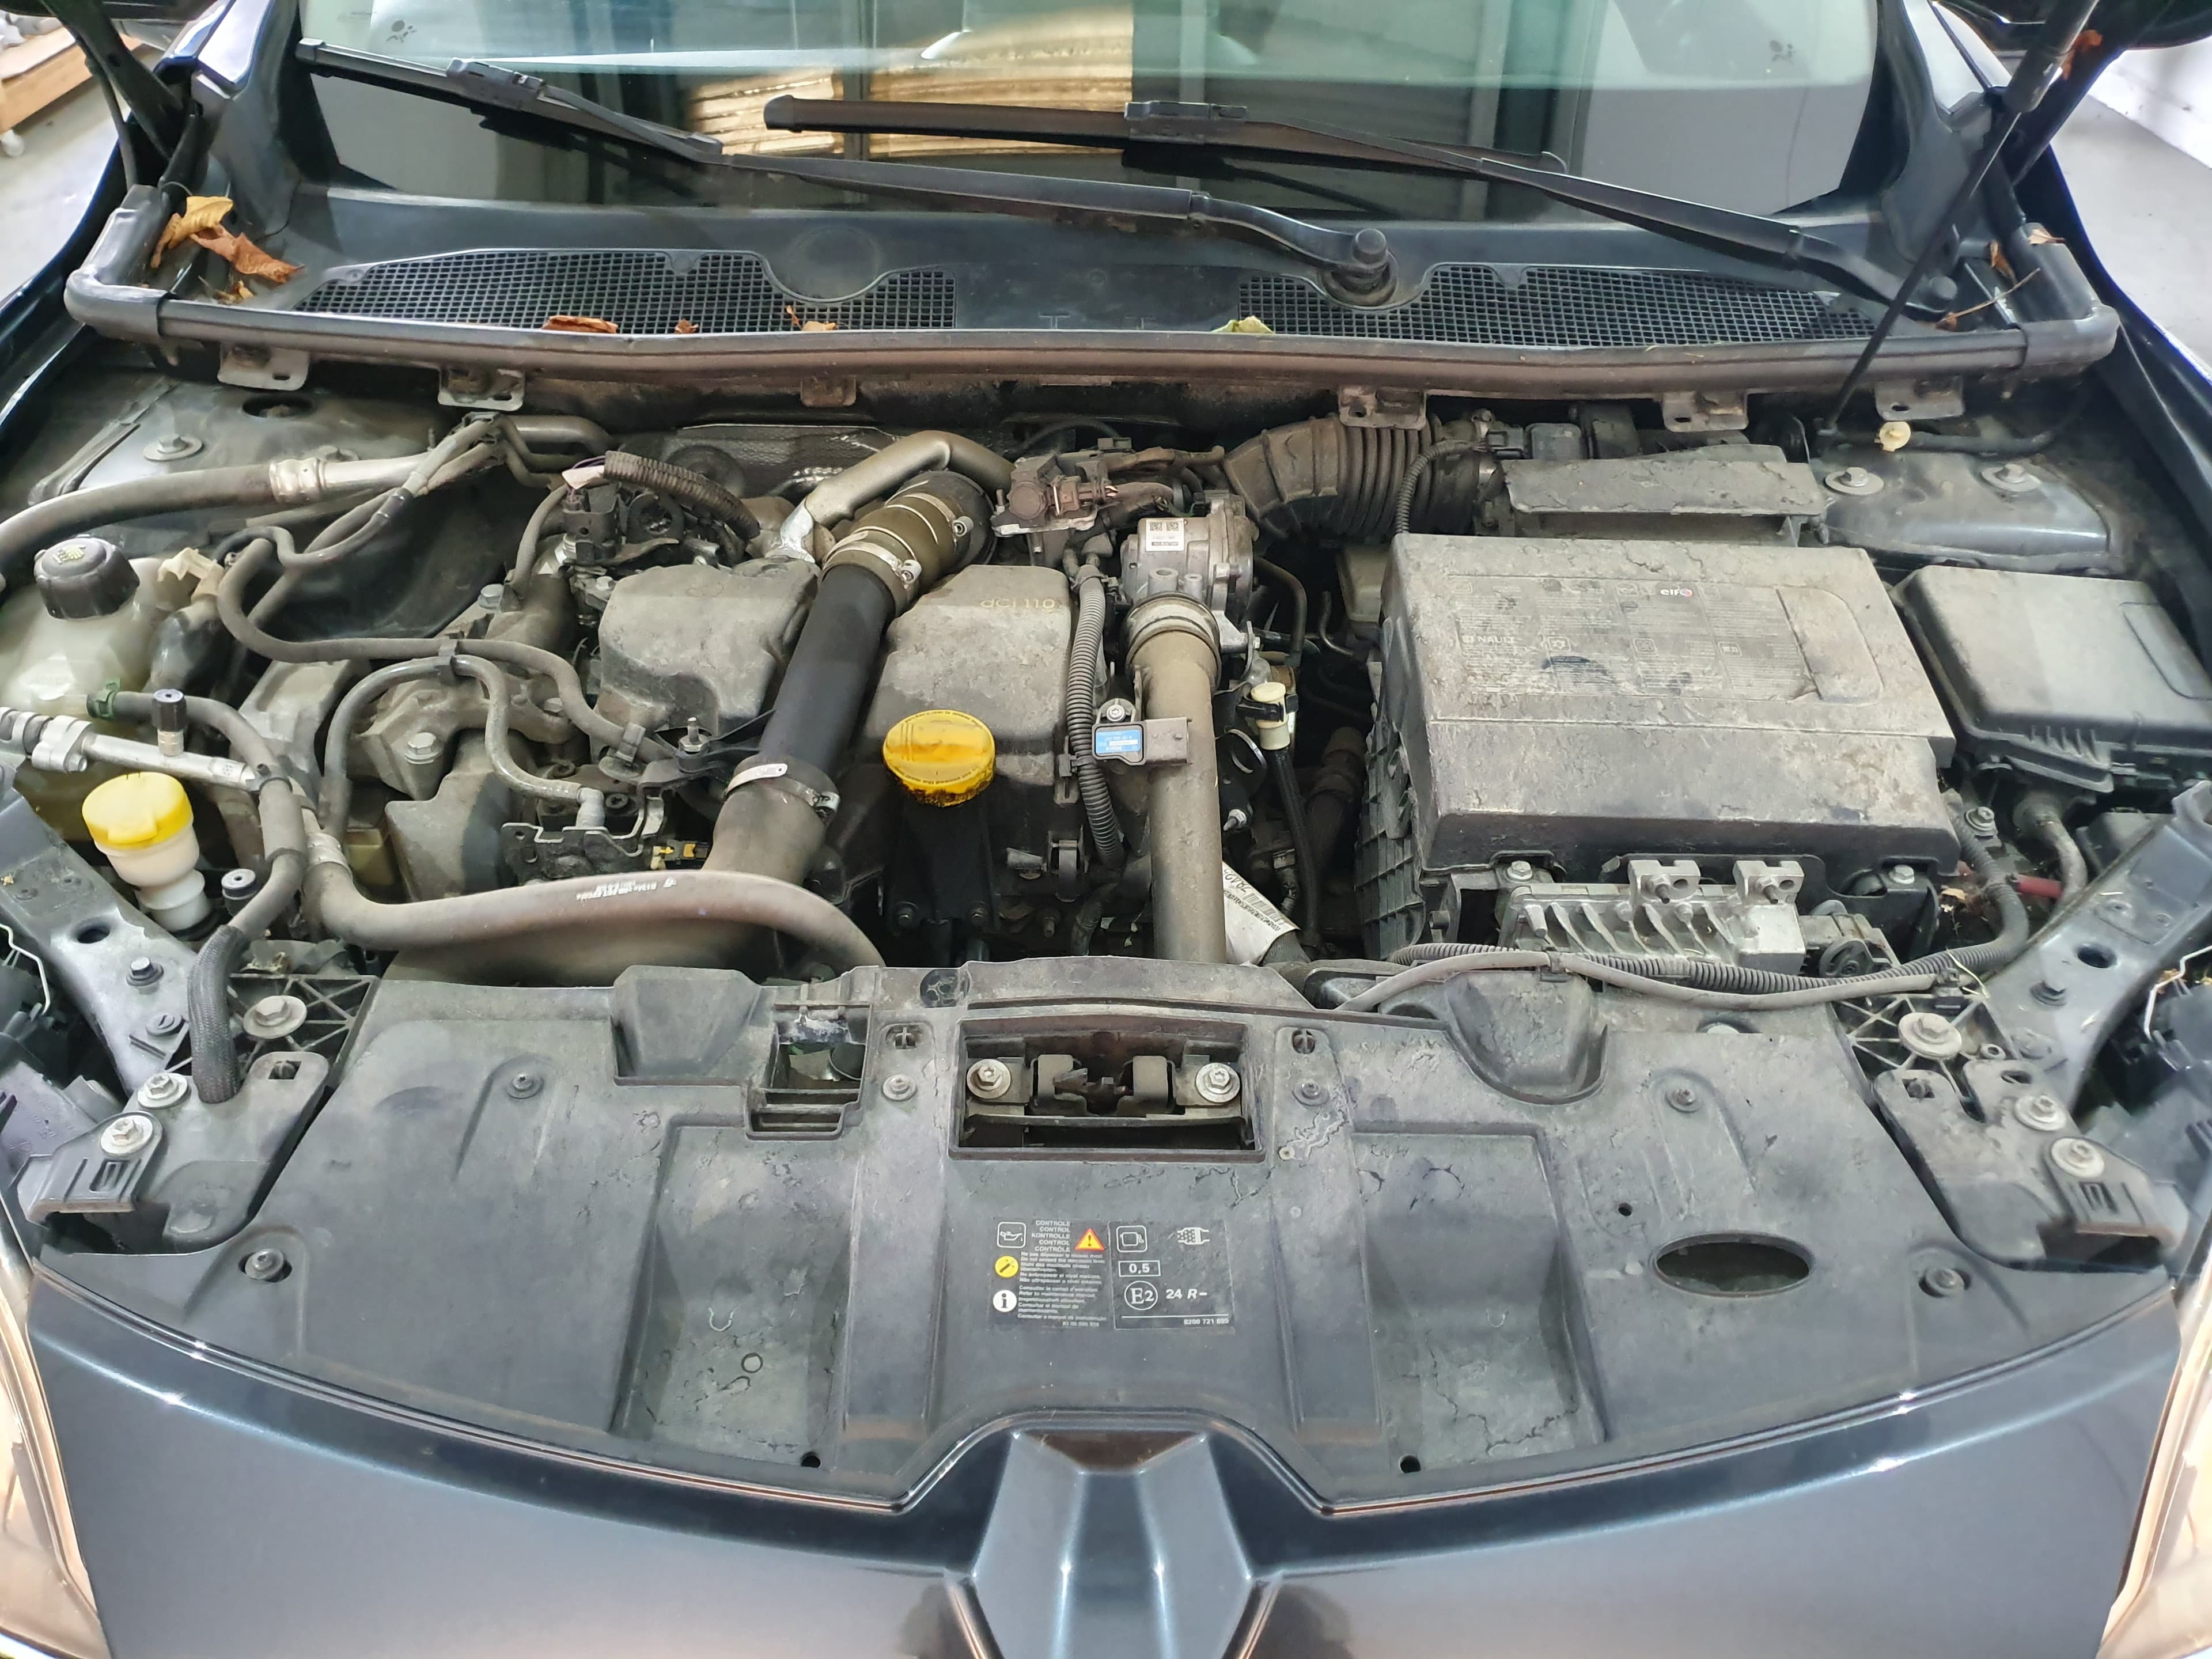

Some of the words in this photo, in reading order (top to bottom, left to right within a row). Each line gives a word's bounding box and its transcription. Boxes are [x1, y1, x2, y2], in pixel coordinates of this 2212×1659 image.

[1024, 598, 1055, 609] 110
[1128, 1263, 1150, 1274] 0,5
[1130, 1287, 1154, 1304] E2
[1166, 1289, 1183, 1299] 24
